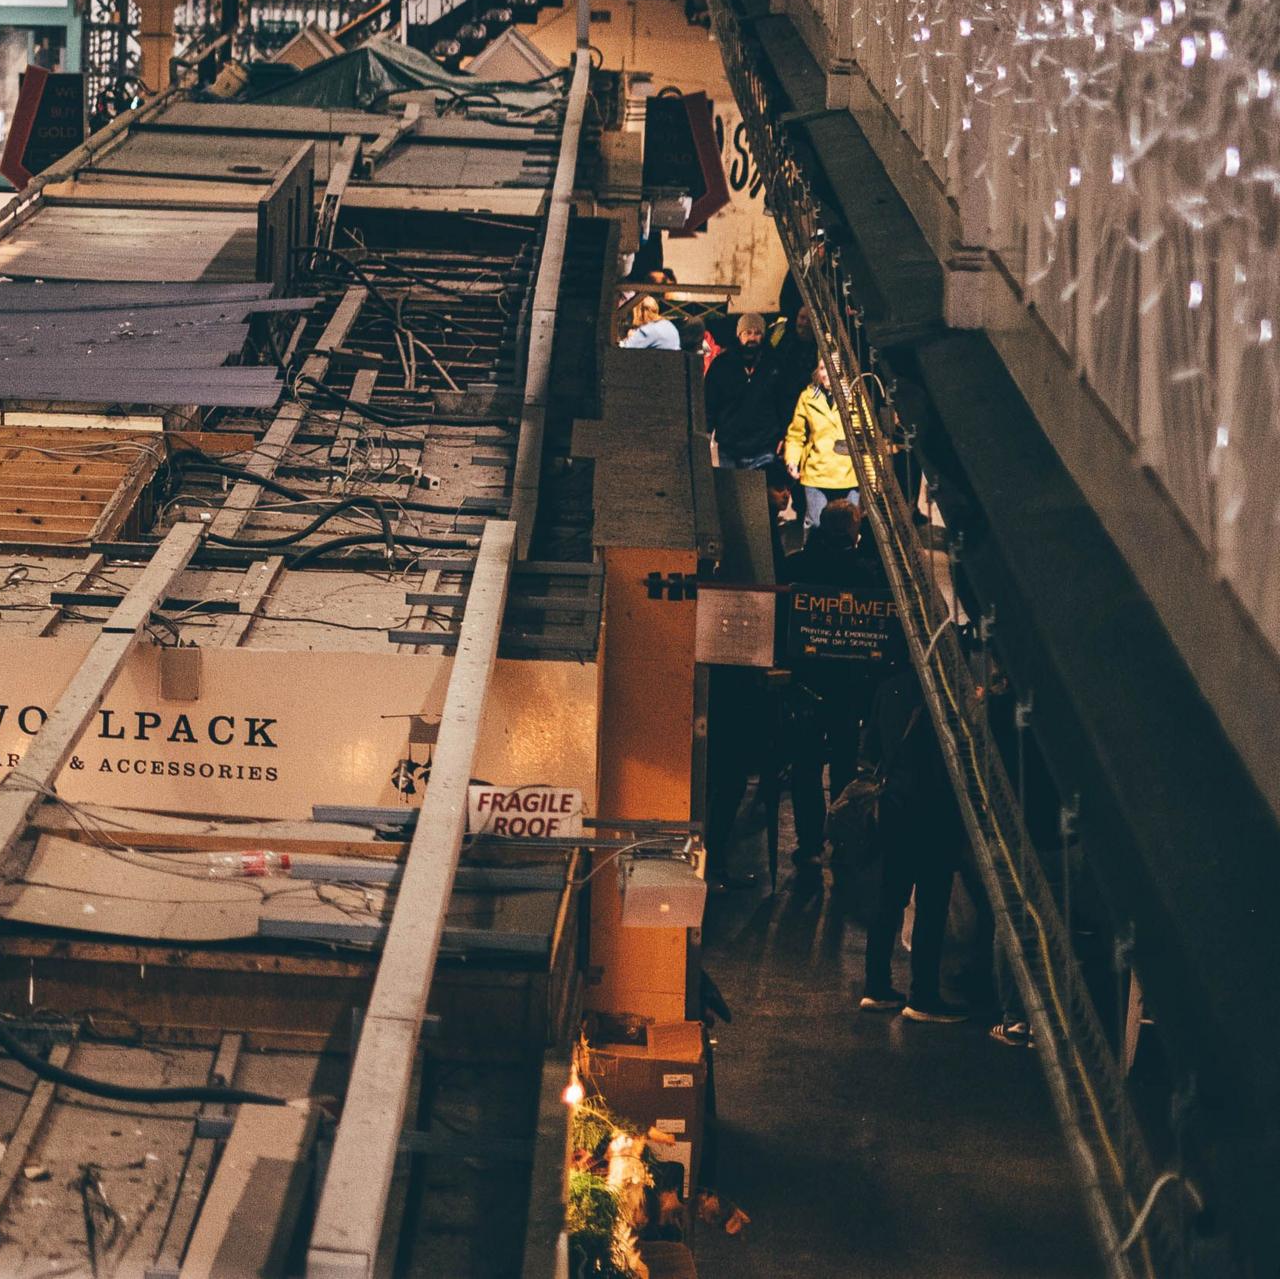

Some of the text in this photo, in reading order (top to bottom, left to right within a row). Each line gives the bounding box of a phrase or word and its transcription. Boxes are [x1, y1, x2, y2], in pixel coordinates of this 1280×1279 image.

[795, 593, 900, 618] EMPOWER
[835, 629, 841, 637] &
[69, 755, 85, 770] &
[98, 758, 278, 782] ACCESSORIES
[477, 792, 574, 814] FRAGILE
[493, 817, 561, 837] ROOF
